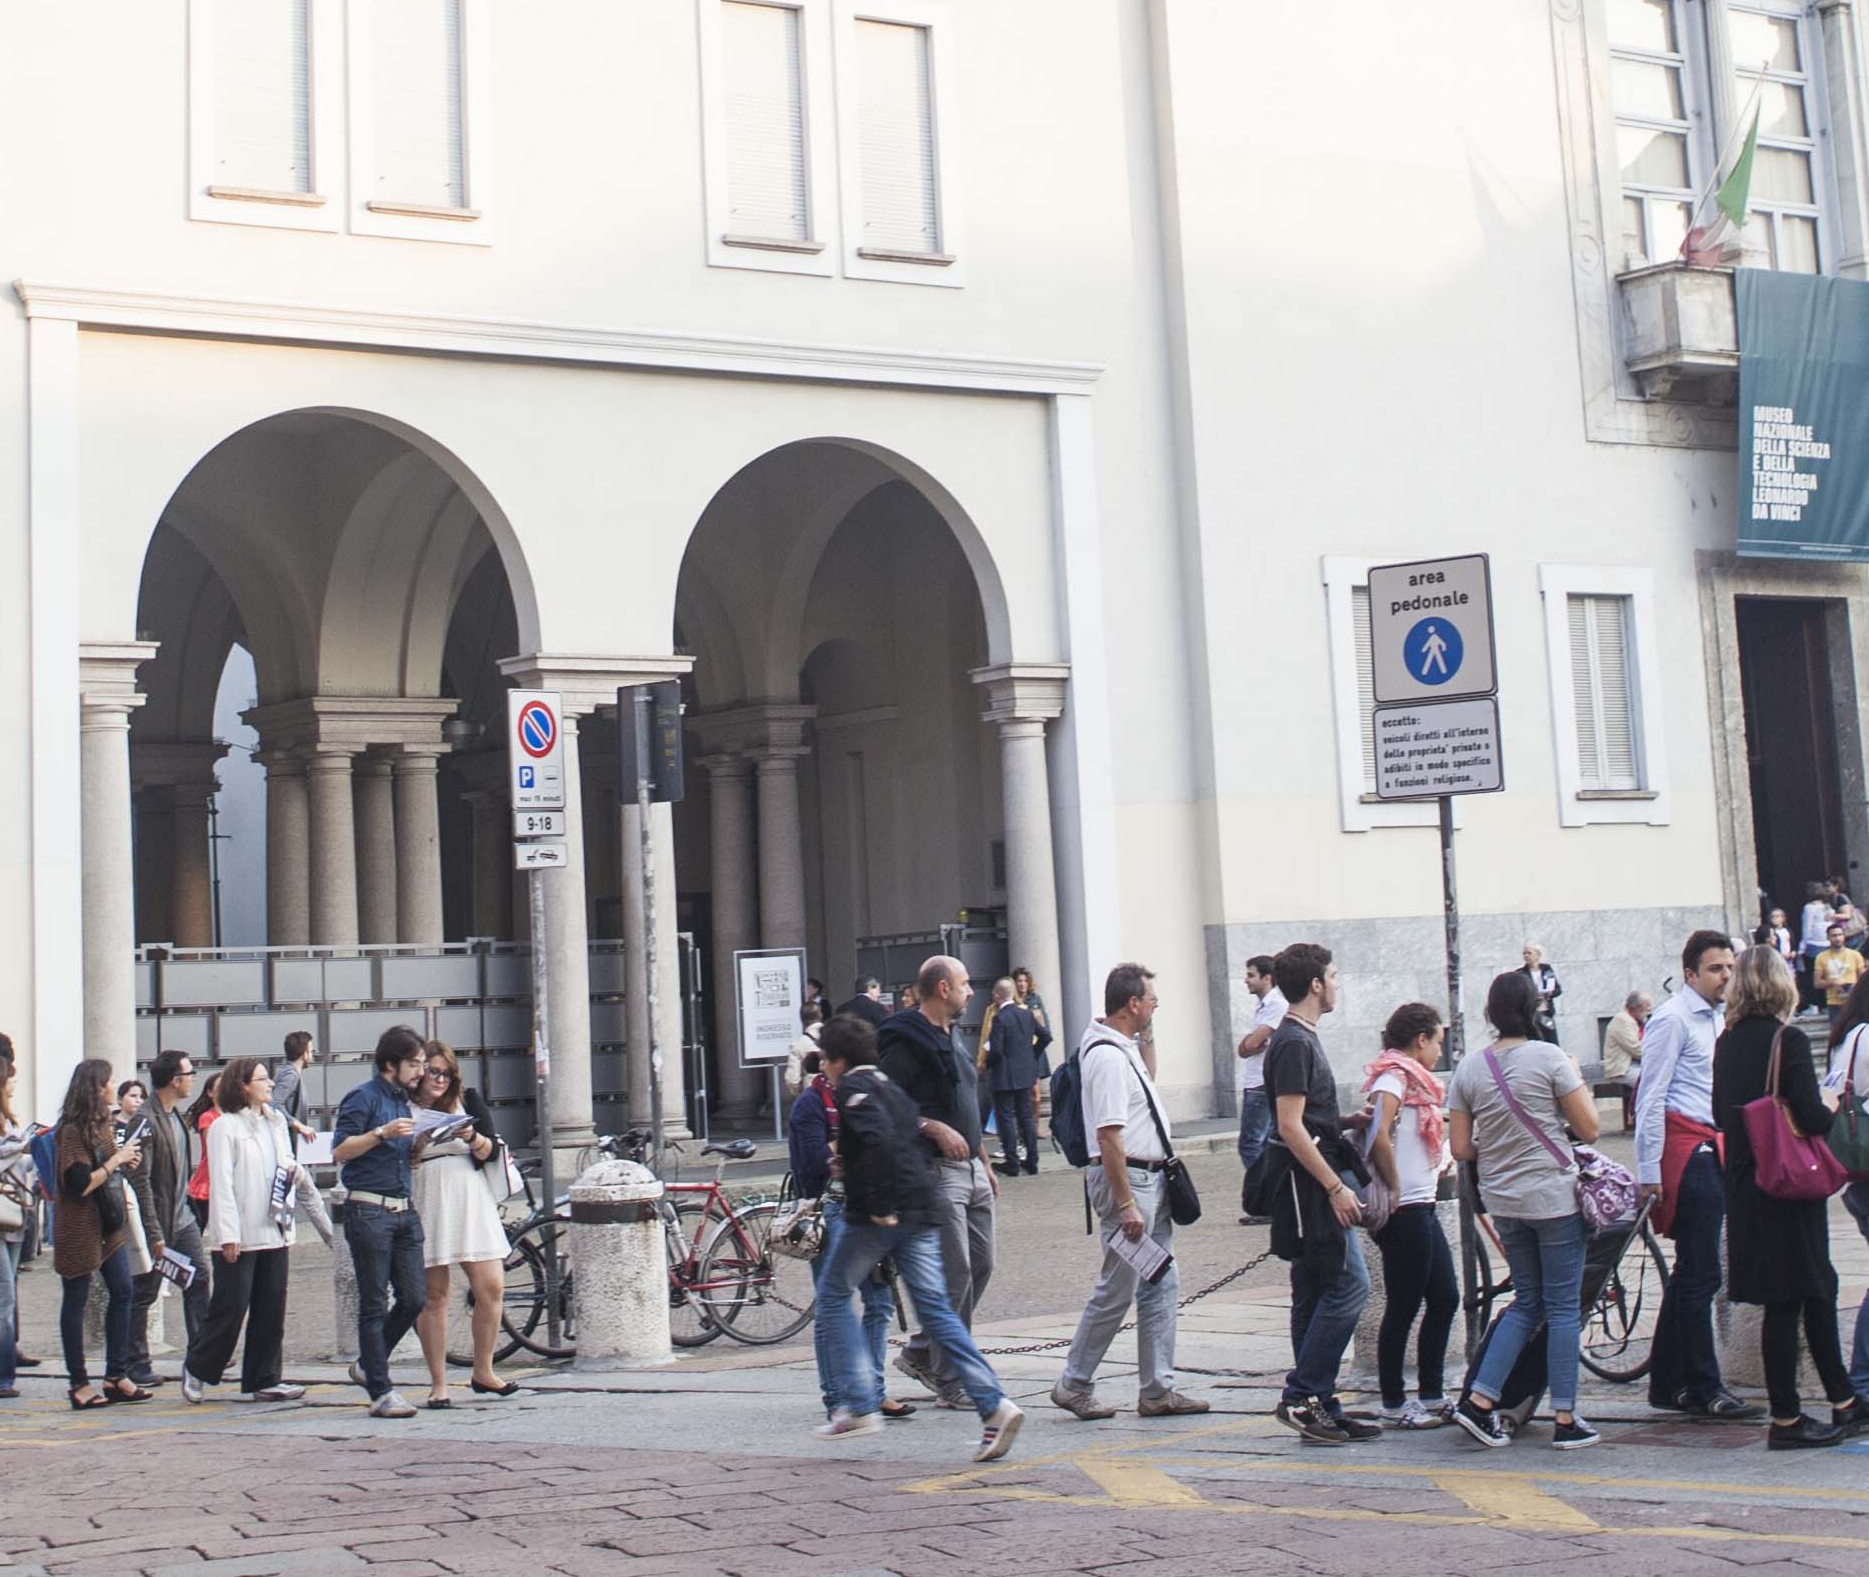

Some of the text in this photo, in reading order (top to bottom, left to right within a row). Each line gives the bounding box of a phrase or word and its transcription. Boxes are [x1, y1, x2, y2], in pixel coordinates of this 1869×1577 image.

[1753, 406, 1793, 423] MUSEO
[1753, 422, 1813, 441] NAZIONALE
[1753, 438, 1830, 459] DELLA SCIENZA
[1753, 455, 1795, 472] E DELLA
[1752, 471, 1817, 490] TECNOLOGIA
[1752, 487, 1808, 505] LEONARDO
[1752, 503, 1801, 521] DA VINCI
[1409, 571, 1445, 586] area
[1391, 590, 1469, 616] pedonale
[1382, 716, 1421, 728] eccetto:
[1383, 733, 1411, 744] veicoli
[1414, 730, 1441, 741] diretti
[1452, 742, 1482, 755] private
[1384, 756, 1491, 774] adibiti in modo specifico
[521, 768, 532, 786] P
[1394, 777, 1429, 788] funzioni
[527, 816, 552, 831] 9-18
[271, 1166, 288, 1209] INFO
[155, 1258, 180, 1280] INF
